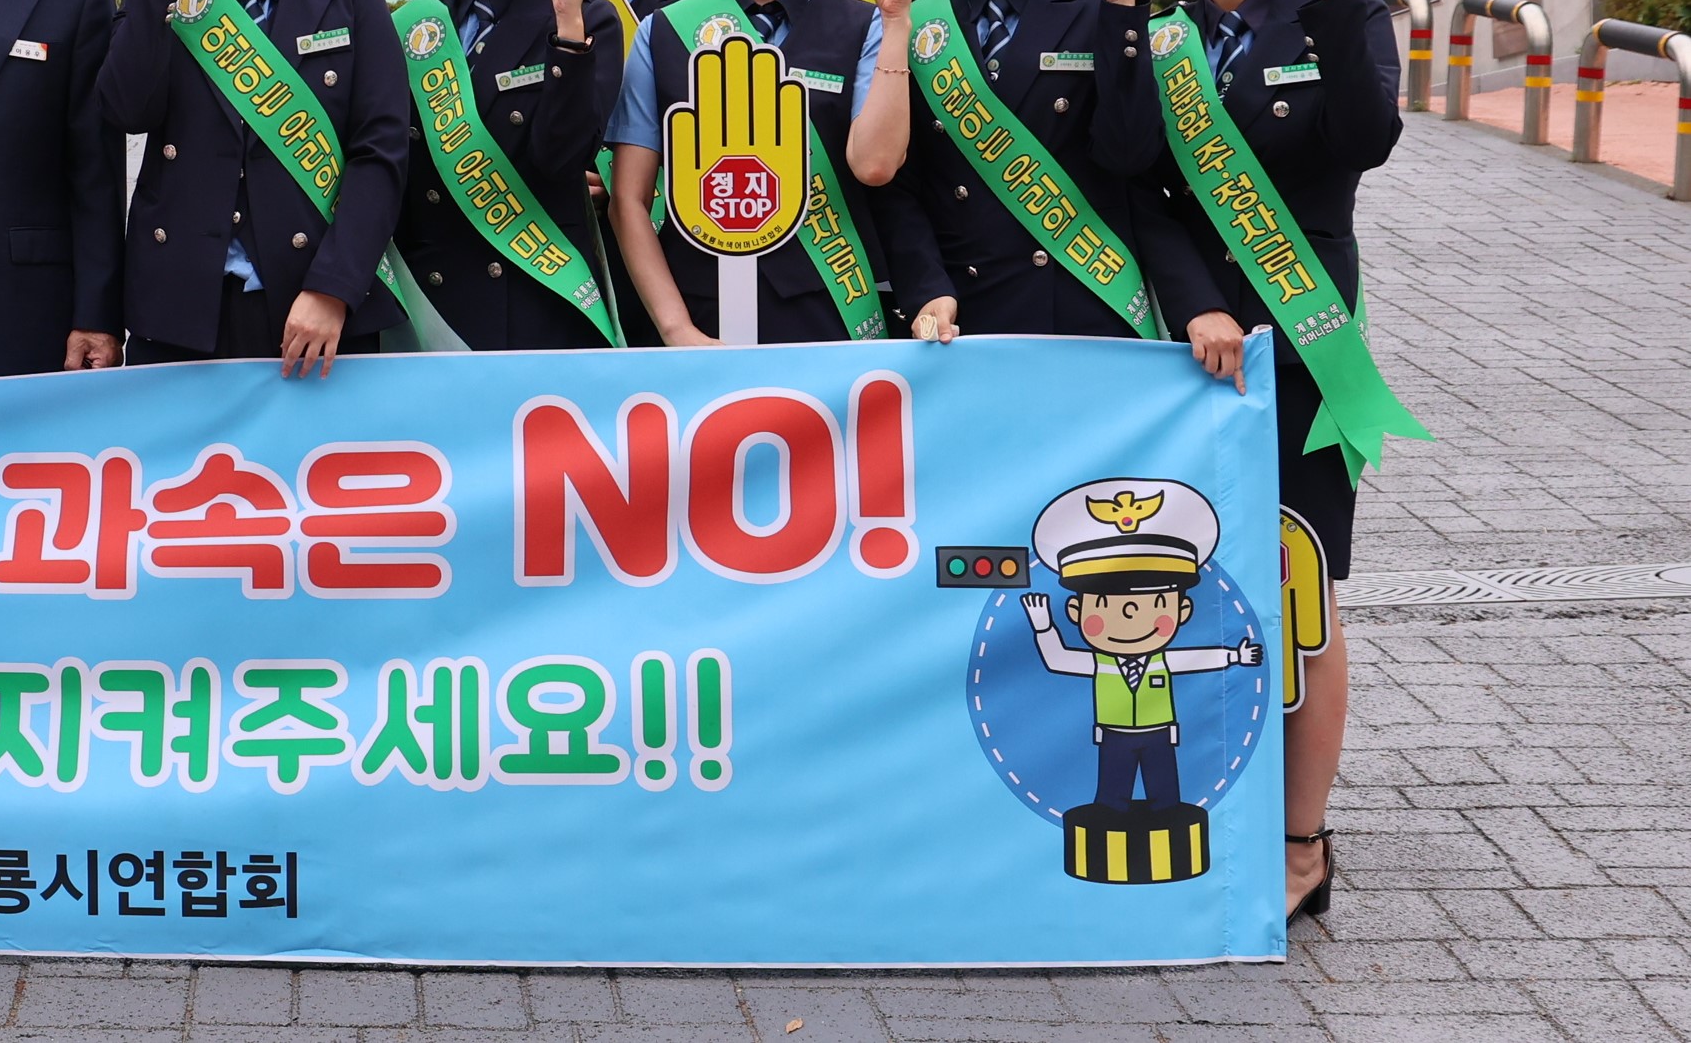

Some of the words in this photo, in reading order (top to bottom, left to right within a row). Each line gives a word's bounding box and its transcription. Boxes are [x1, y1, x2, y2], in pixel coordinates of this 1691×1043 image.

[199, 14, 293, 118] 어린이는
[1162, 56, 1213, 143] 교문앞
[420, 58, 473, 155] 어린이는
[454, 148, 523, 234] 우리의
[508, 221, 571, 277] 미래
[709, 197, 772, 220] STOP
[930, 56, 1015, 164] 어린이는
[1000, 153, 1079, 241] 우리의
[1064, 225, 1127, 287] 미래
[523, 377, 912, 580] NO!
